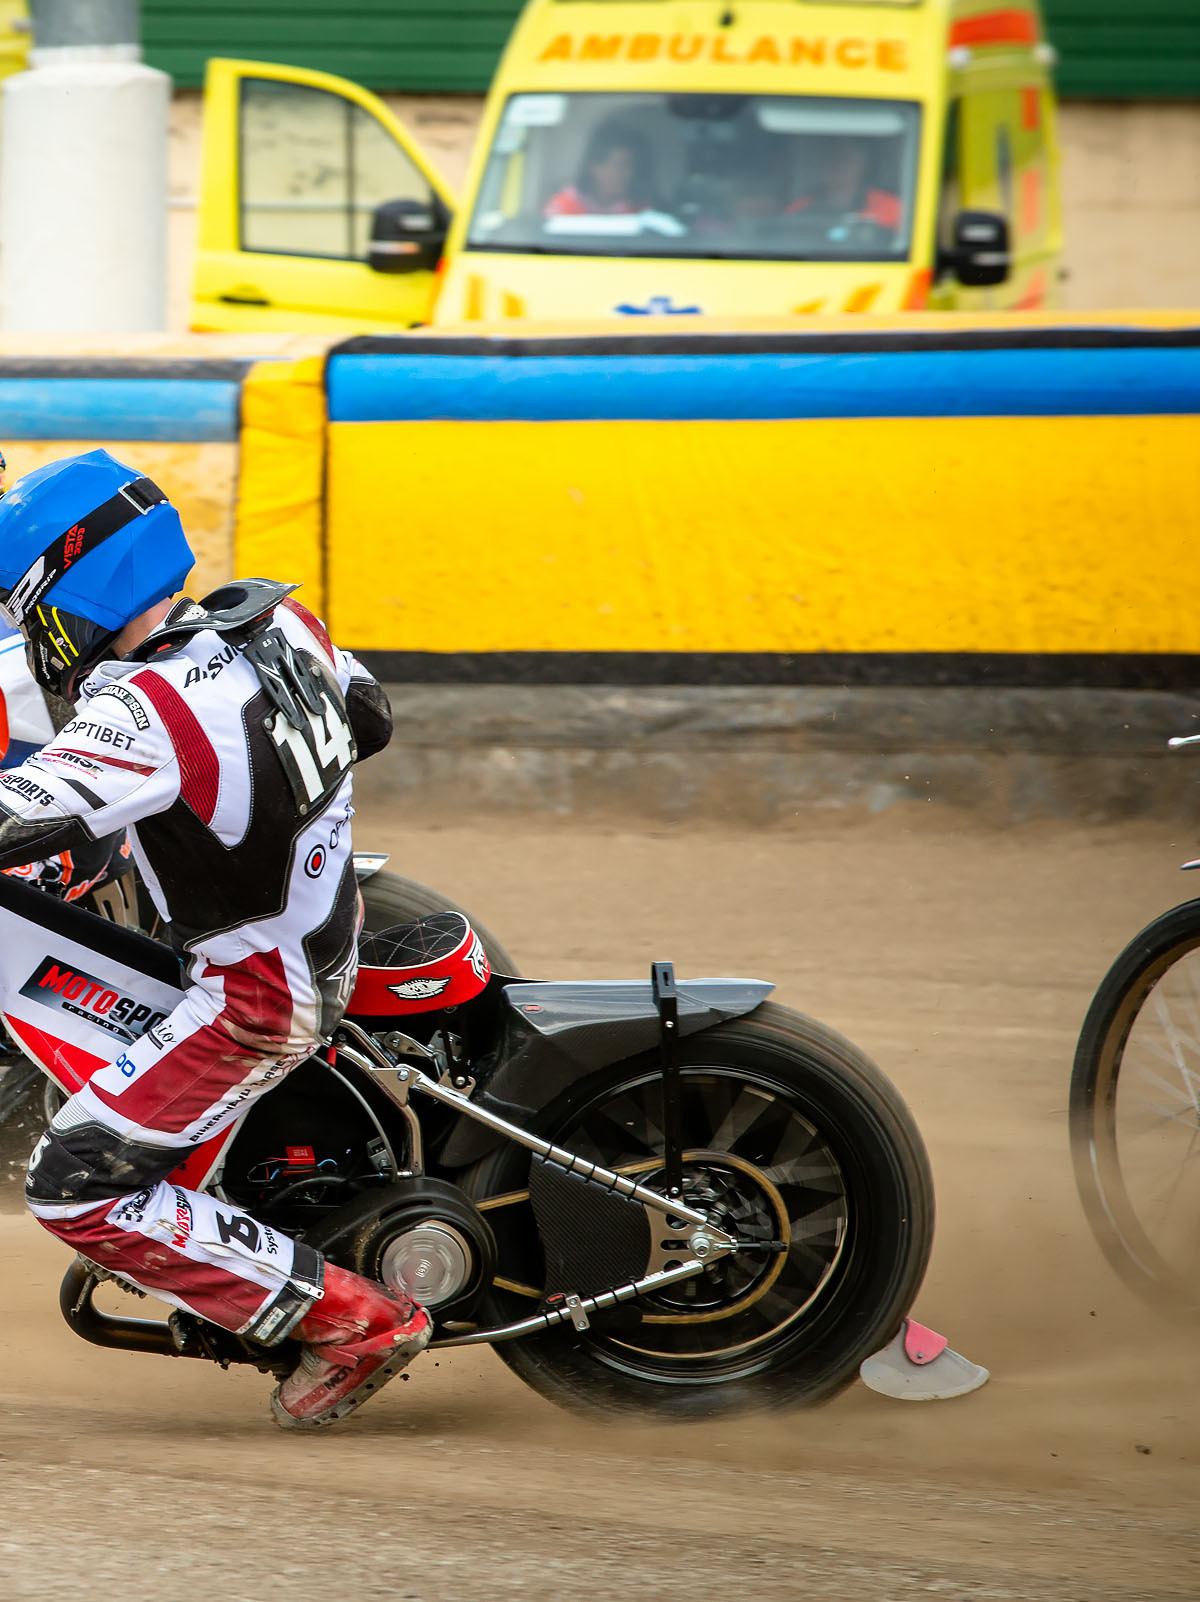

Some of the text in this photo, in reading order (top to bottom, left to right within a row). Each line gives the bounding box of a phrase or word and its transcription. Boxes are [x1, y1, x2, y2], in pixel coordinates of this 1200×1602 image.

[539, 32, 907, 72] AMBULANCE
[63, 524, 79, 569] VISTA
[24, 568, 57, 615] PROGRIP
[63, 721, 136, 751] OPTIBET
[271, 692, 352, 803] 14
